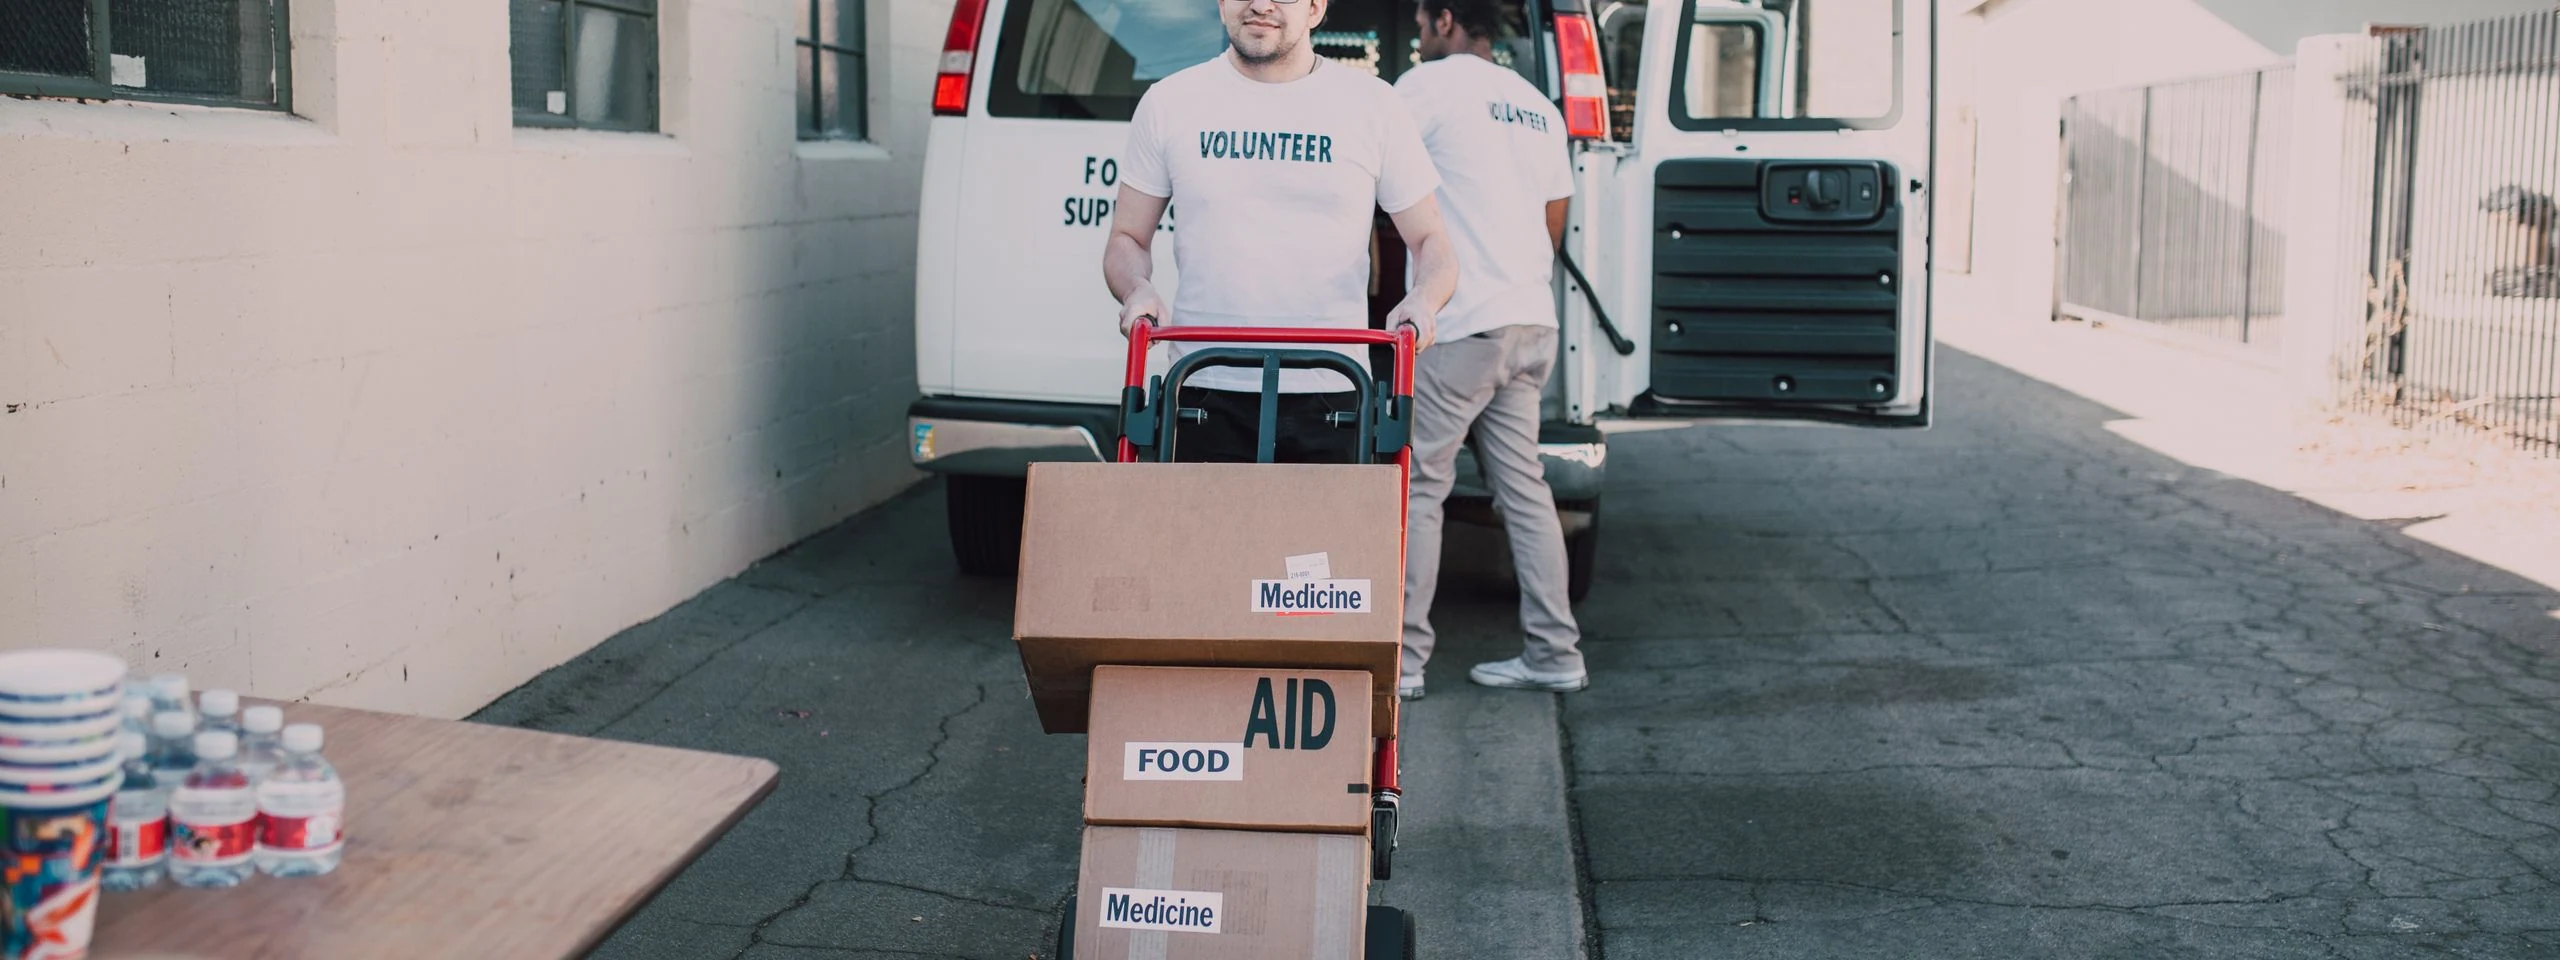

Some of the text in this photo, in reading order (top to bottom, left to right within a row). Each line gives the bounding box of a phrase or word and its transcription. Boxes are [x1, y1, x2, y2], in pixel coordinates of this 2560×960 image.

[1200, 131, 1333, 163] VOLUNTEER
[1085, 157, 1118, 186] FO
[1260, 582, 1362, 609] Medicine
[1244, 677, 1336, 750] AID
[1138, 749, 1230, 773] FOOD
[1106, 893, 1213, 927] Medicine
